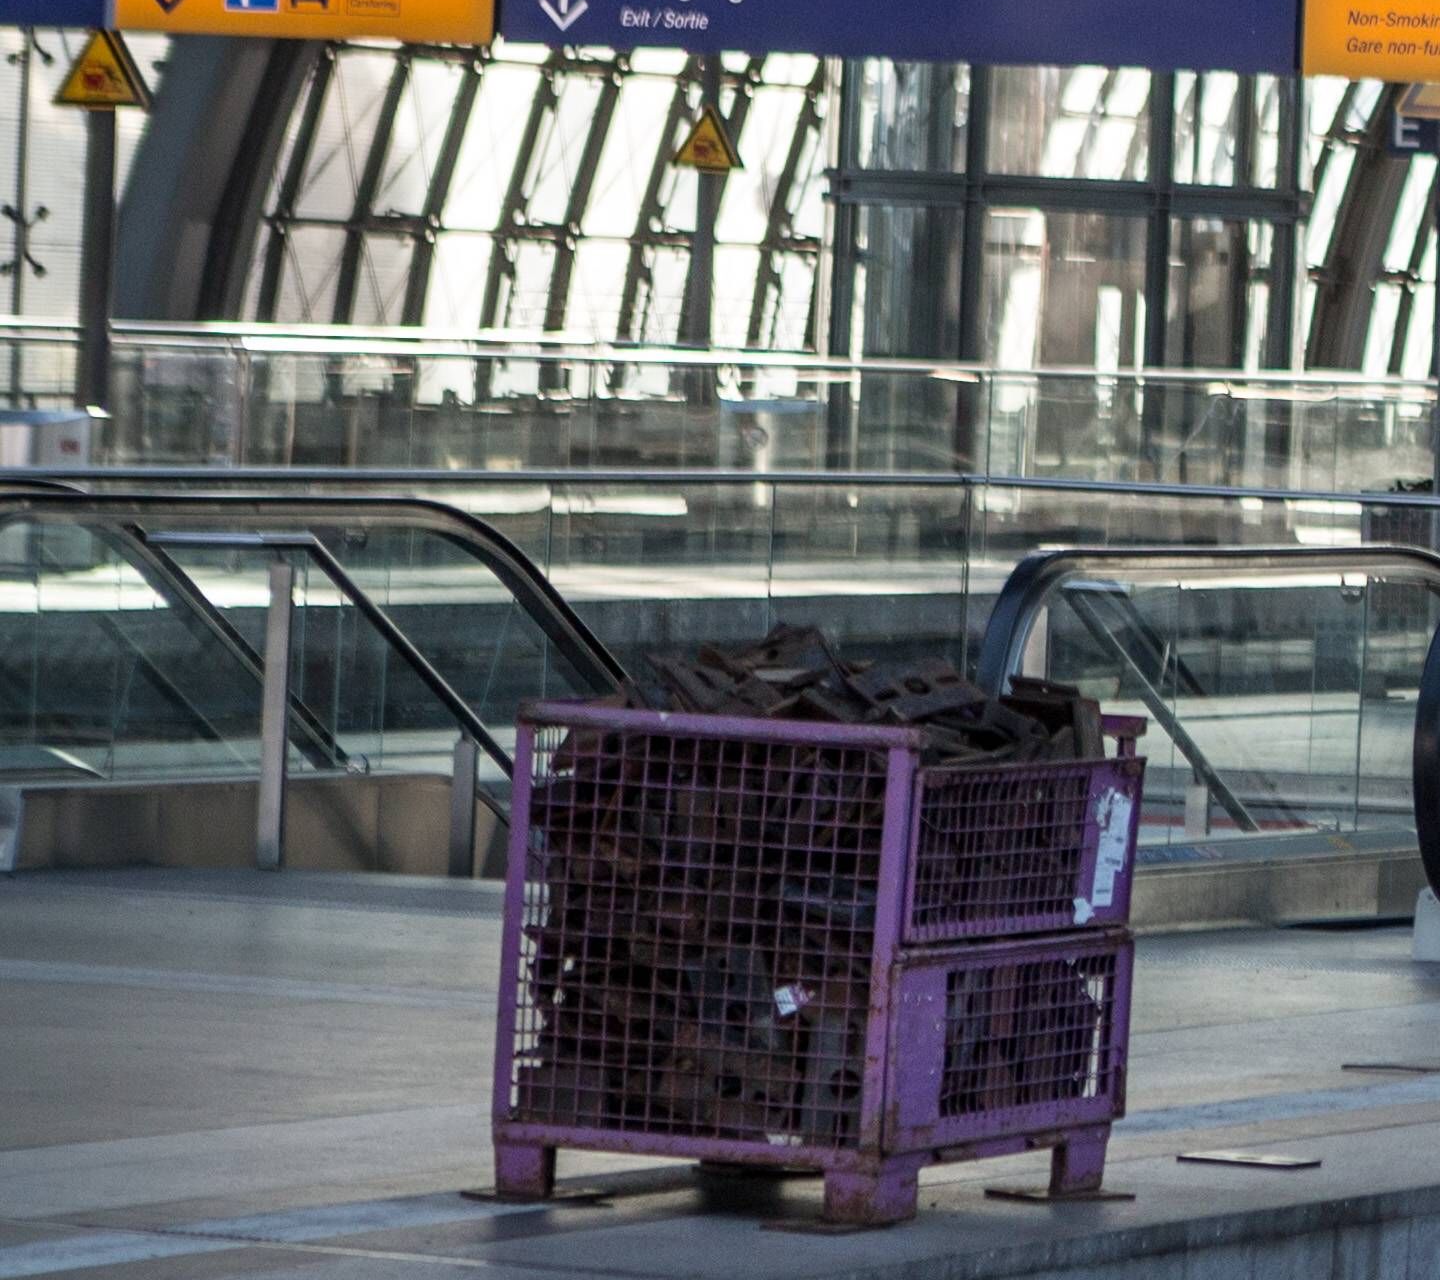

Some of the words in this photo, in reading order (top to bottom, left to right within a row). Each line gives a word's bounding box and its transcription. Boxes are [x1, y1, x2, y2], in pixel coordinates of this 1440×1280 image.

[620, 8, 652, 28] Exit
[663, 10, 709, 30] Sortie
[1346, 36, 1383, 54] Gare
